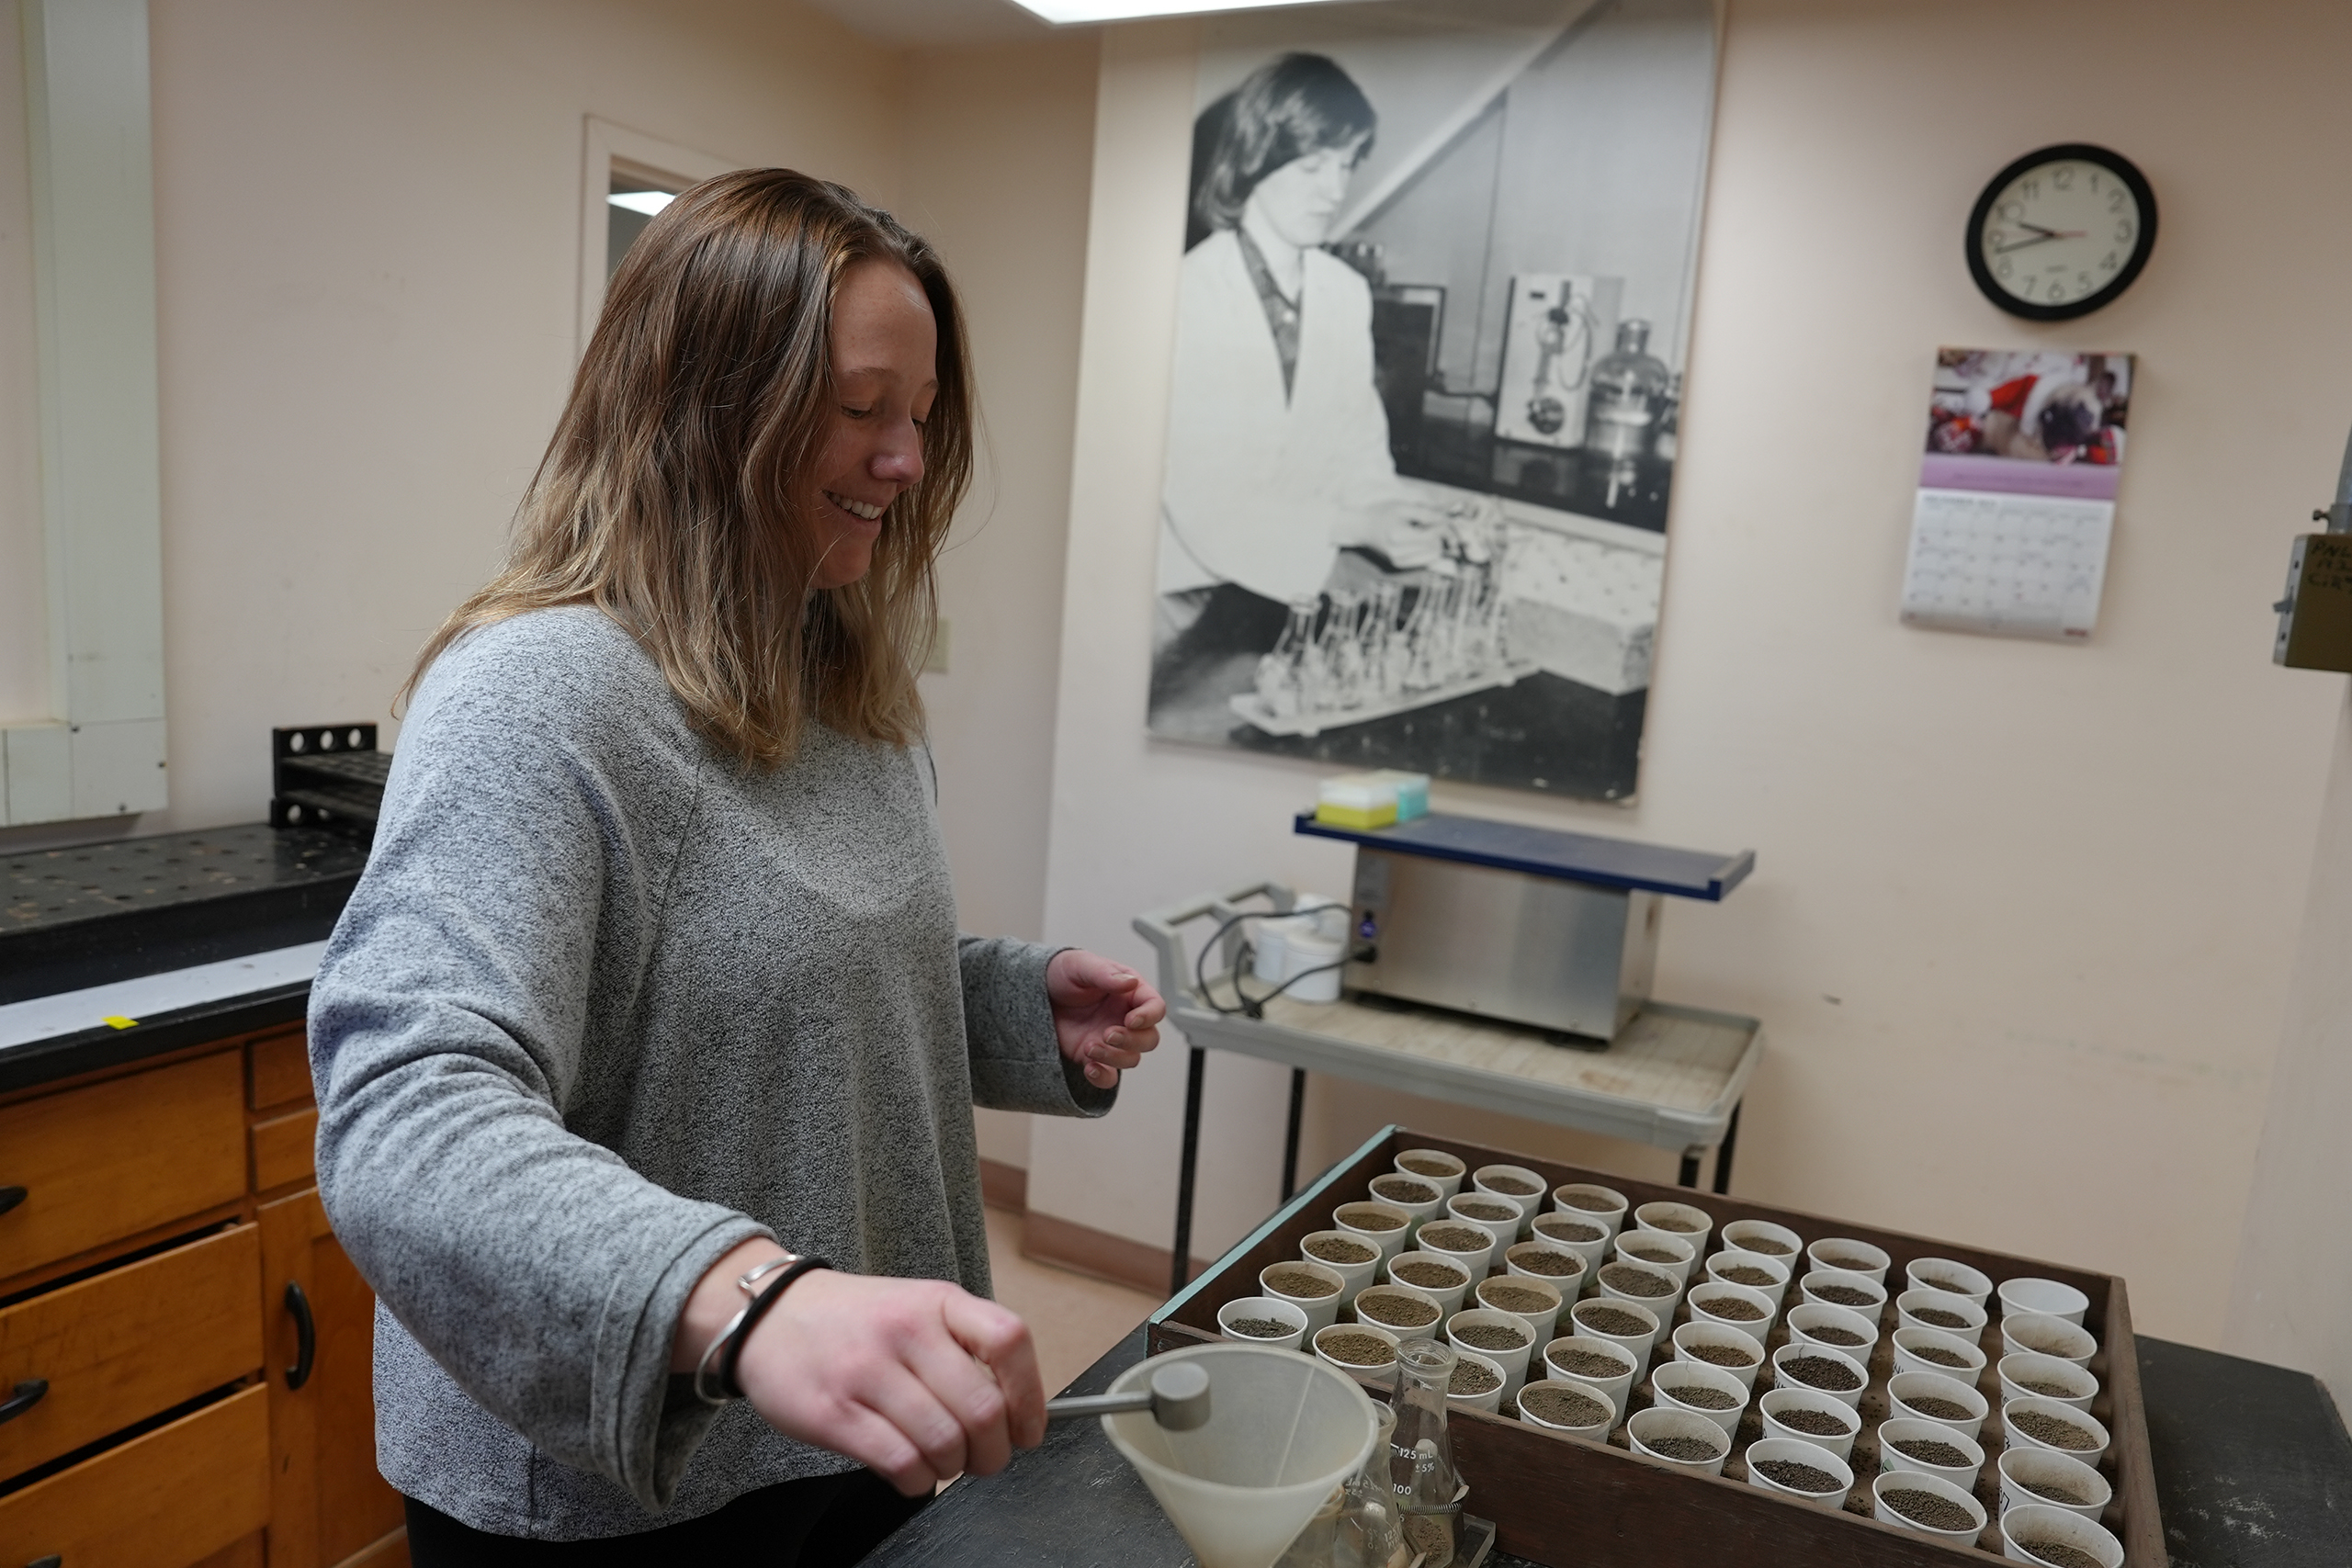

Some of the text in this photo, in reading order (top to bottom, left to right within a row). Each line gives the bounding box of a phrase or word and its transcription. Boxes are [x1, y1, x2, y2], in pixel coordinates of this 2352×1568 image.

[2052, 164, 2076, 191] 12
[2090, 173, 2098, 195] 1
[2020, 179, 2040, 200] 11
[2107, 187, 2127, 214] 2
[1996, 198, 2025, 223] 10
[2113, 218, 2132, 243] 3
[1996, 255, 2014, 279] 8
[2098, 251, 2117, 270] 4
[2021, 274, 2037, 296] 7
[2047, 279, 2065, 301] 6
[2075, 271, 2093, 294] 5
[1399, 1448, 1433, 1460] 125 mL
[1393, 1483, 1412, 1495] 100
